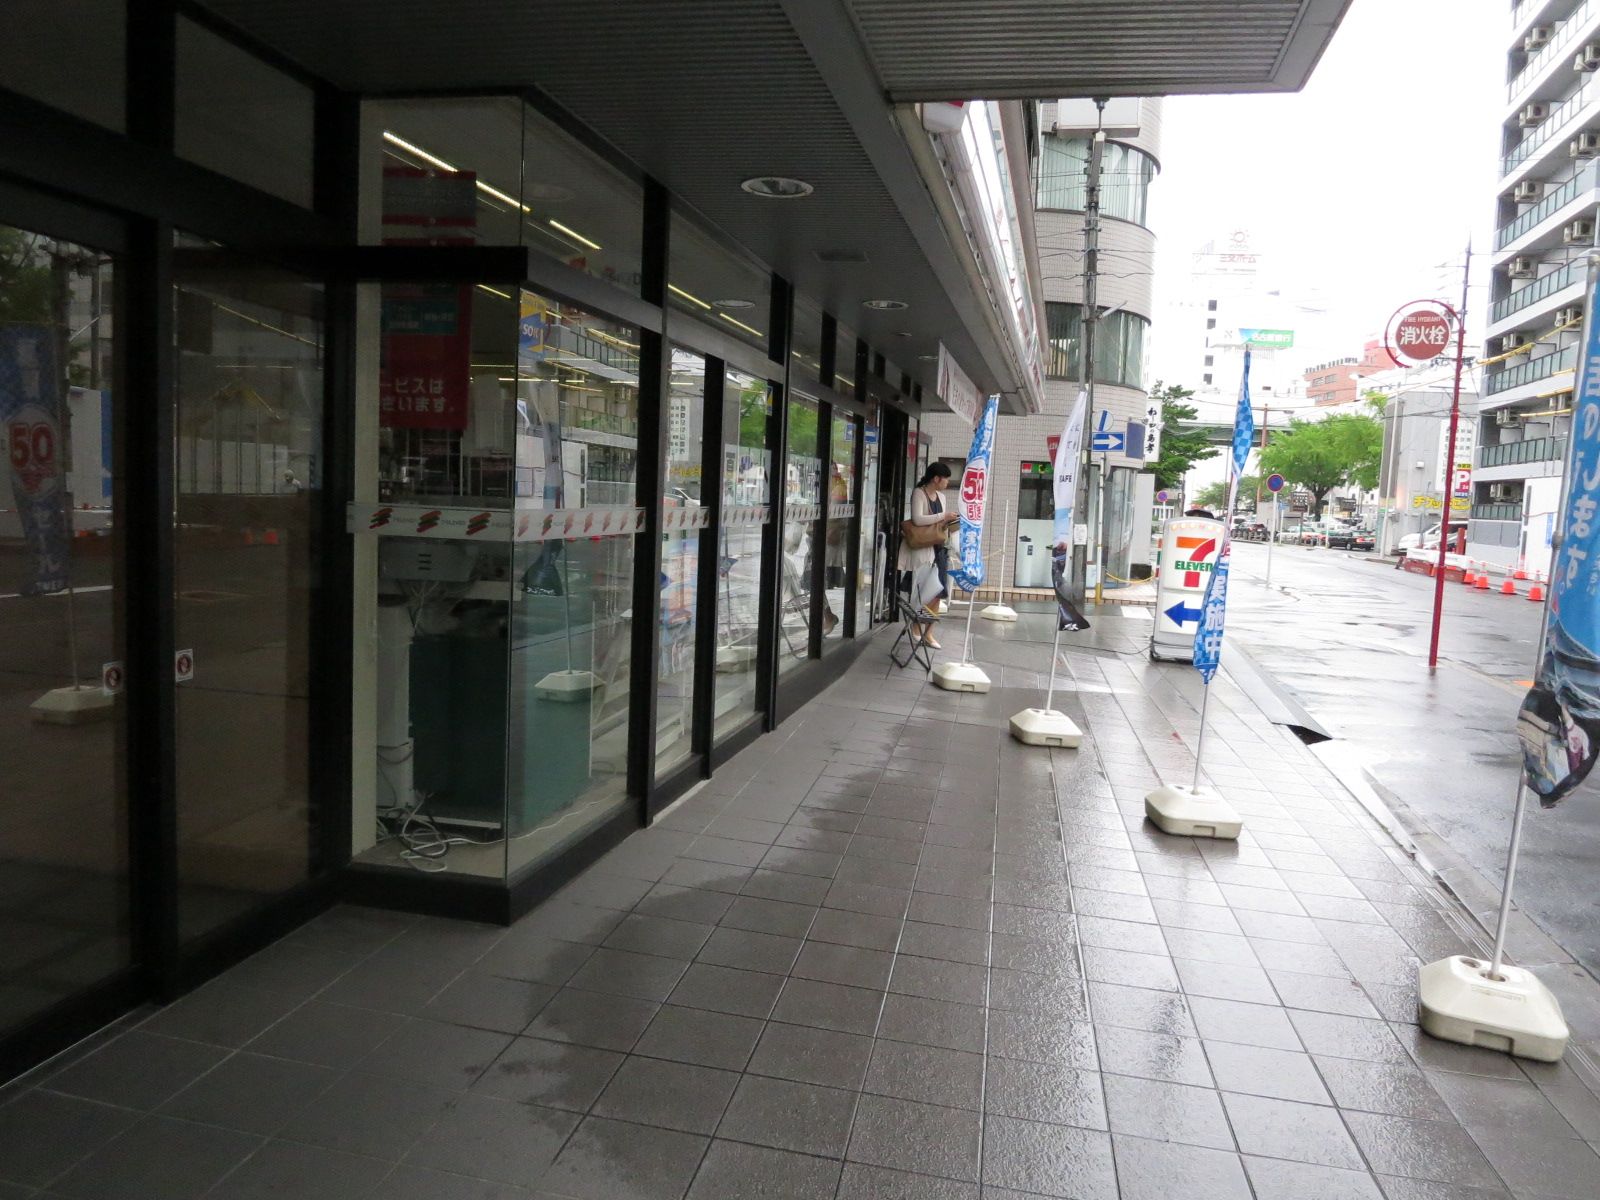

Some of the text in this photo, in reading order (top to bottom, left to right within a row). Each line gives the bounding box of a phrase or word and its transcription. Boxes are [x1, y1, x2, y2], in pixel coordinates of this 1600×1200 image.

[1400, 325, 1446, 345] 消火栓
[1176, 536, 1216, 587] 7
